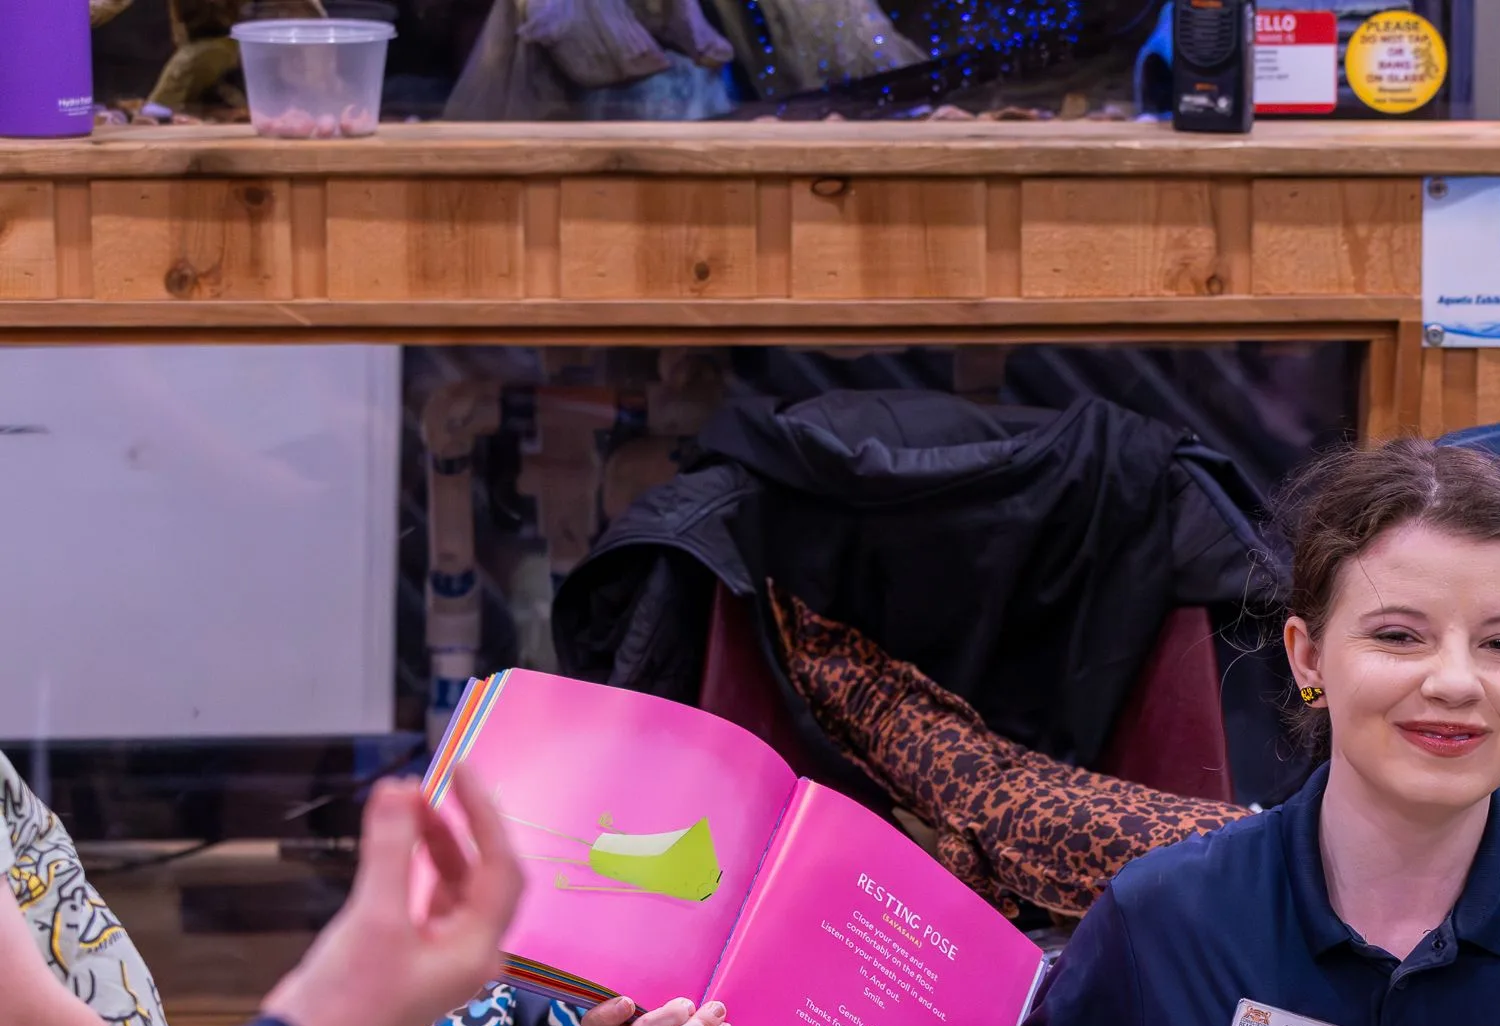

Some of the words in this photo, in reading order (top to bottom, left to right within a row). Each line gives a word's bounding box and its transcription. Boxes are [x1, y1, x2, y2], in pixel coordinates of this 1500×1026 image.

[1255, 14, 1297, 32] ELLO
[1366, 20, 1420, 32] PLEASE
[856, 872, 922, 930] RESTING
[923, 924, 959, 961] POSE
[846, 921, 892, 960] comfortably
[891, 956, 902, 968] on
[902, 963, 915, 978] the
[915, 973, 934, 995] floor.
[852, 910, 875, 931] Close
[873, 927, 893, 944] your
[892, 942, 909, 959] eyes
[908, 955, 924, 970] and
[923, 967, 939, 982] rest
[820, 919, 845, 942] Listen
[845, 937, 855, 949] to
[854, 945, 873, 962] your
[872, 957, 897, 982] breath
[896, 979, 911, 992] roll
[910, 987, 918, 999] in
[917, 995, 933, 1010] and
[932, 1007, 947, 1022] out.
[859, 965, 869, 979] In.
[869, 974, 887, 991] And
[885, 988, 900, 1003] out.
[805, 997, 832, 1023] Thanks
[863, 986, 886, 1010] Smile.
